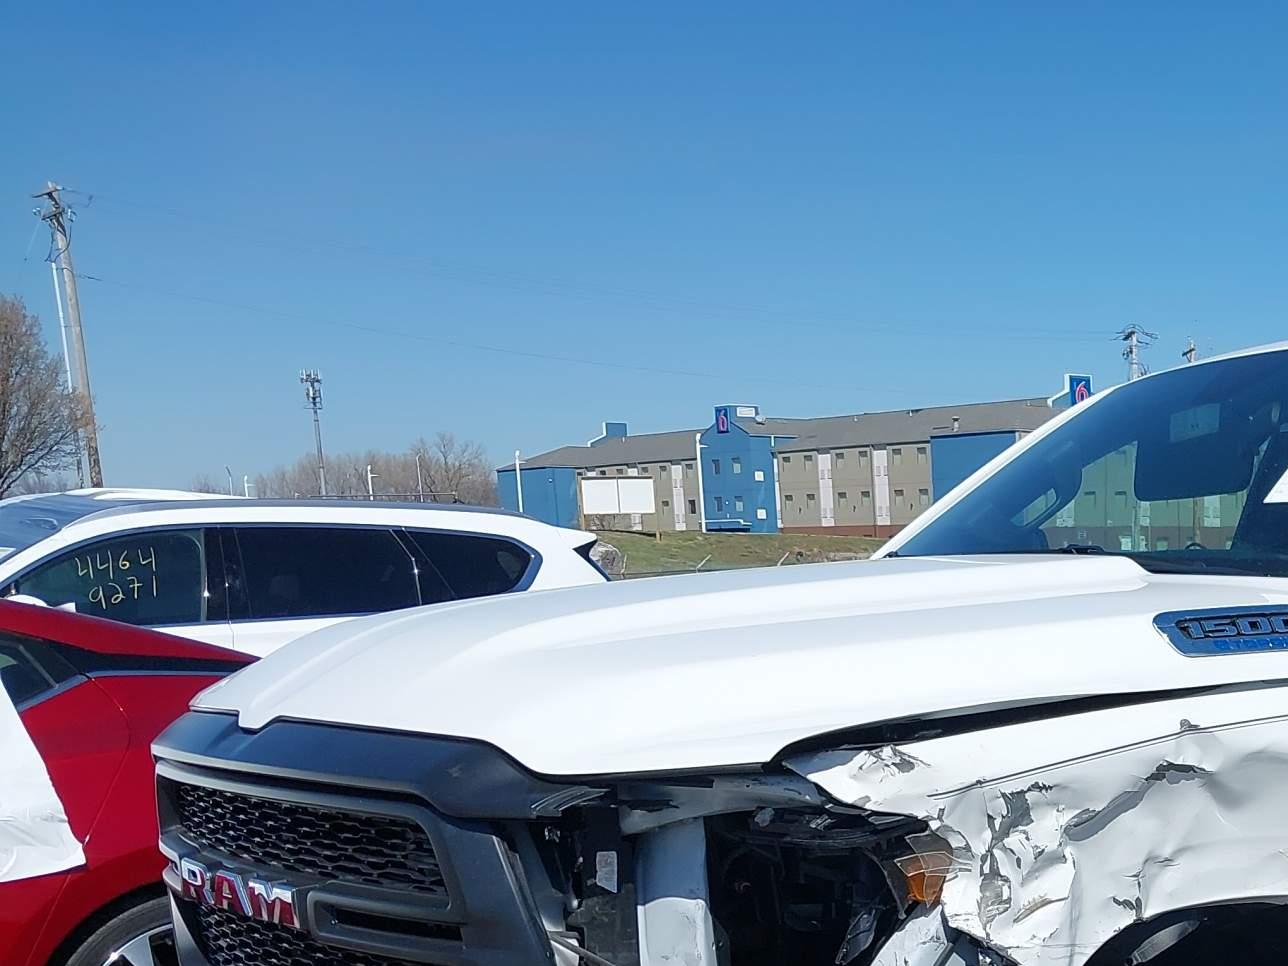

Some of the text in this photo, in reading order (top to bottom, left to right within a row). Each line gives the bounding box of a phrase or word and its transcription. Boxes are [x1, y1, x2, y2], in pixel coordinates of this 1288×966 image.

[1075, 380, 1089, 404] 6
[717, 409, 728, 432] 6
[75, 546, 156, 580] 4464
[88, 575, 157, 610] 9271
[180, 856, 300, 929] RAM
